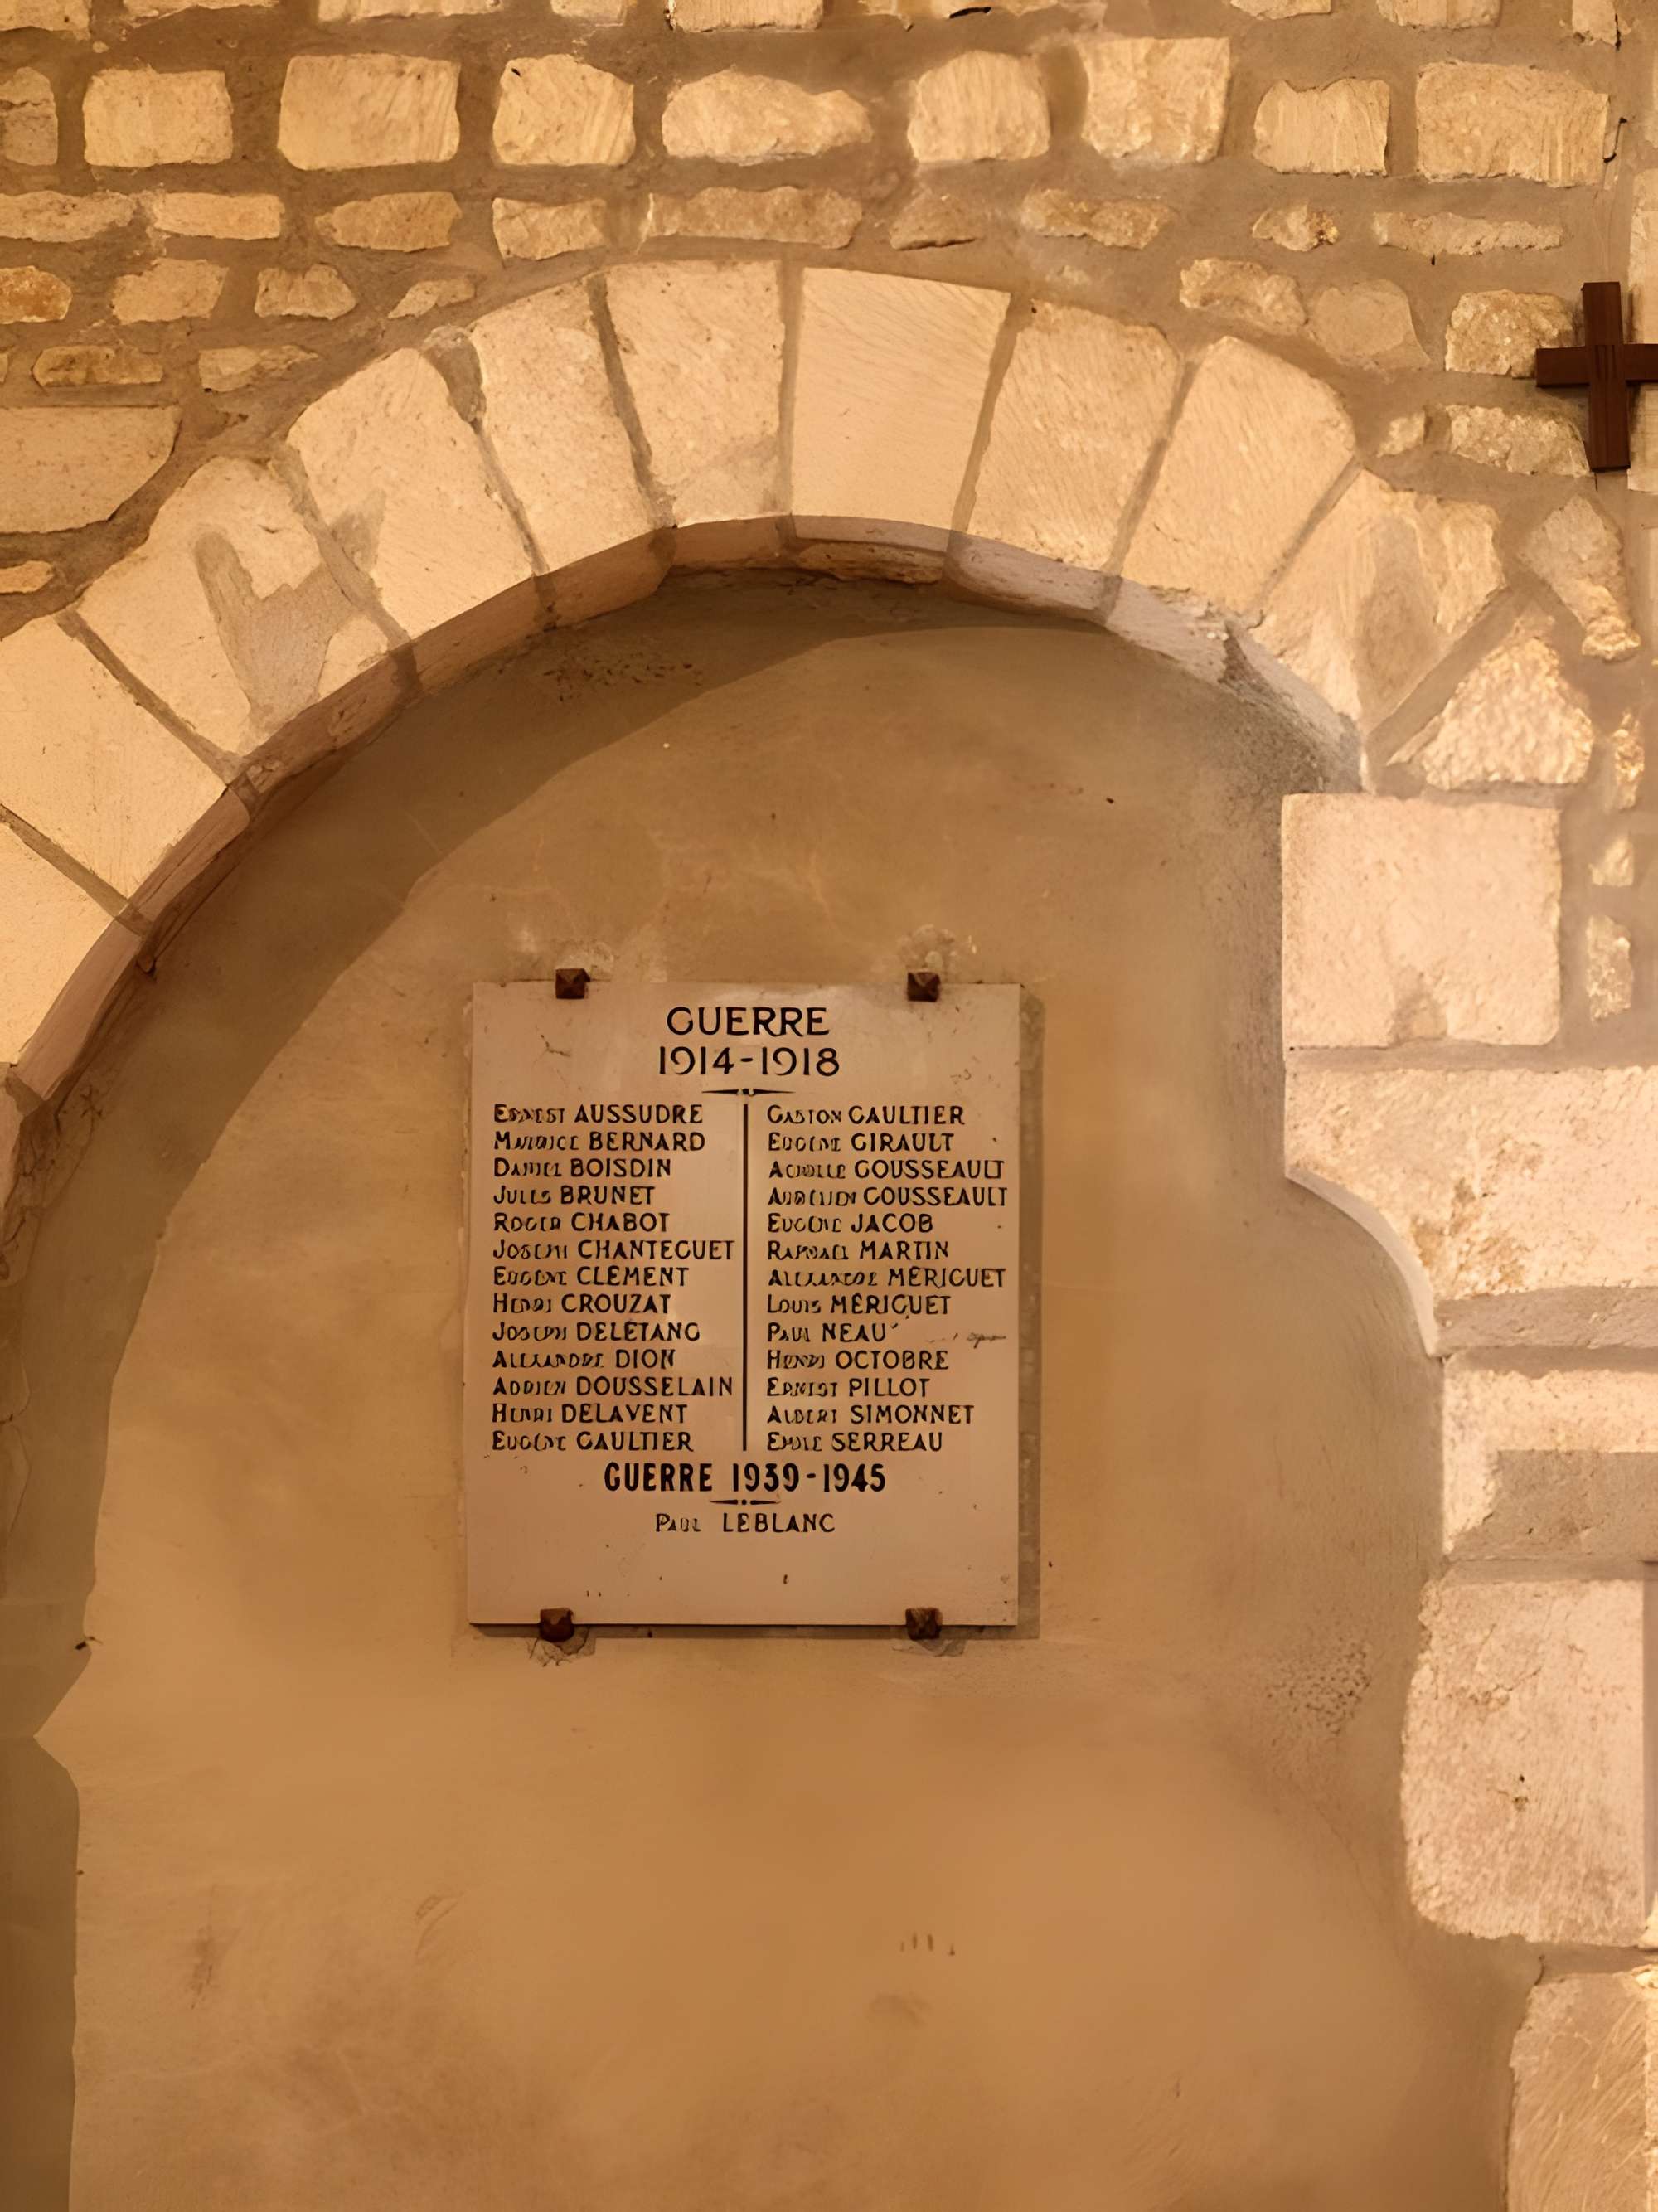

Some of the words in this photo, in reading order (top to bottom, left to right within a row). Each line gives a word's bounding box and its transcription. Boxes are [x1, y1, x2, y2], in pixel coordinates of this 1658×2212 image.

[666, 1006, 831, 1036] GUERRE
[658, 1045, 840, 1077] 1914-1918
[573, 1103, 704, 1125] AUSSUDRE
[847, 1104, 966, 1126] GAULTIER
[588, 1130, 706, 1152] BERNARD
[850, 1131, 955, 1153] GIRAULT
[570, 1157, 671, 1179] BOISDIN
[853, 1158, 1006, 1181] GOUSSEAULT
[560, 1184, 657, 1206] BRUNET
[862, 1186, 1008, 1207] GOUSSEAULT
[570, 1211, 671, 1234] CHABOT
[850, 1212, 933, 1234] JACOB
[859, 1239, 949, 1261] MARTIN
[560, 1293, 671, 1315] CROUZAT
[766, 1291, 822, 1316] LOUIS
[767, 1321, 812, 1343] PAUL
[822, 1321, 887, 1343] NEAU
[614, 1348, 676, 1370] DION
[835, 1349, 949, 1371] OCTOBRE
[576, 1375, 733, 1398] DOUSSELAIN
[848, 1376, 931, 1398] PILLOT
[560, 1402, 688, 1424] DELAVENT
[850, 1404, 975, 1426] SIMONNET
[575, 1429, 695, 1453] GAULTIER
[831, 1431, 943, 1453] SERREAU
[604, 1461, 713, 1492] GUERRE
[732, 1462, 886, 1492] 1939-1945
[722, 1512, 836, 1533] LEBLANC
